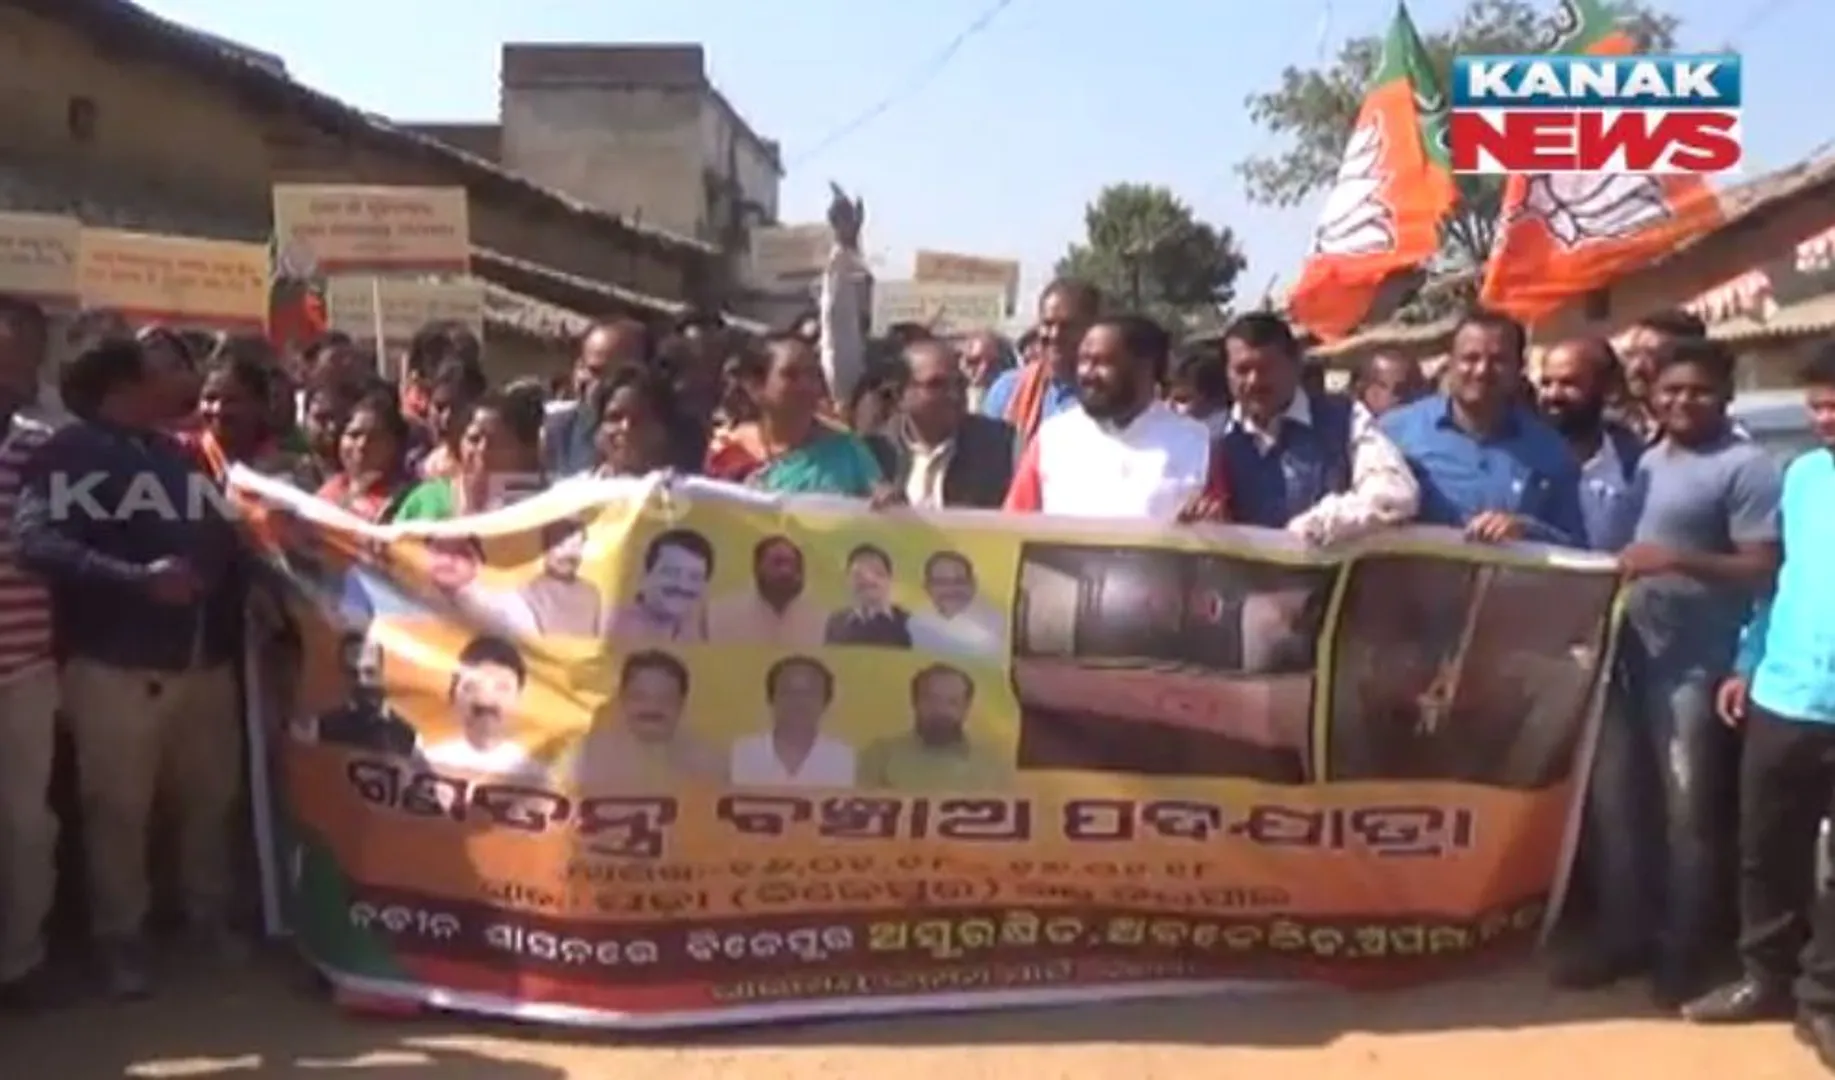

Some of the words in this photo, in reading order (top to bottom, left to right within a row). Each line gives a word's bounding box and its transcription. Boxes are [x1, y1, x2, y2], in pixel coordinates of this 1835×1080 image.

[716, 797, 1031, 844] ବଞ୍ଚାଅ
[349, 901, 460, 940] ନବୀନ
[485, 924, 662, 966] ଶାସନରେ
[686, 926, 855, 963] ବିଜେପୁର
